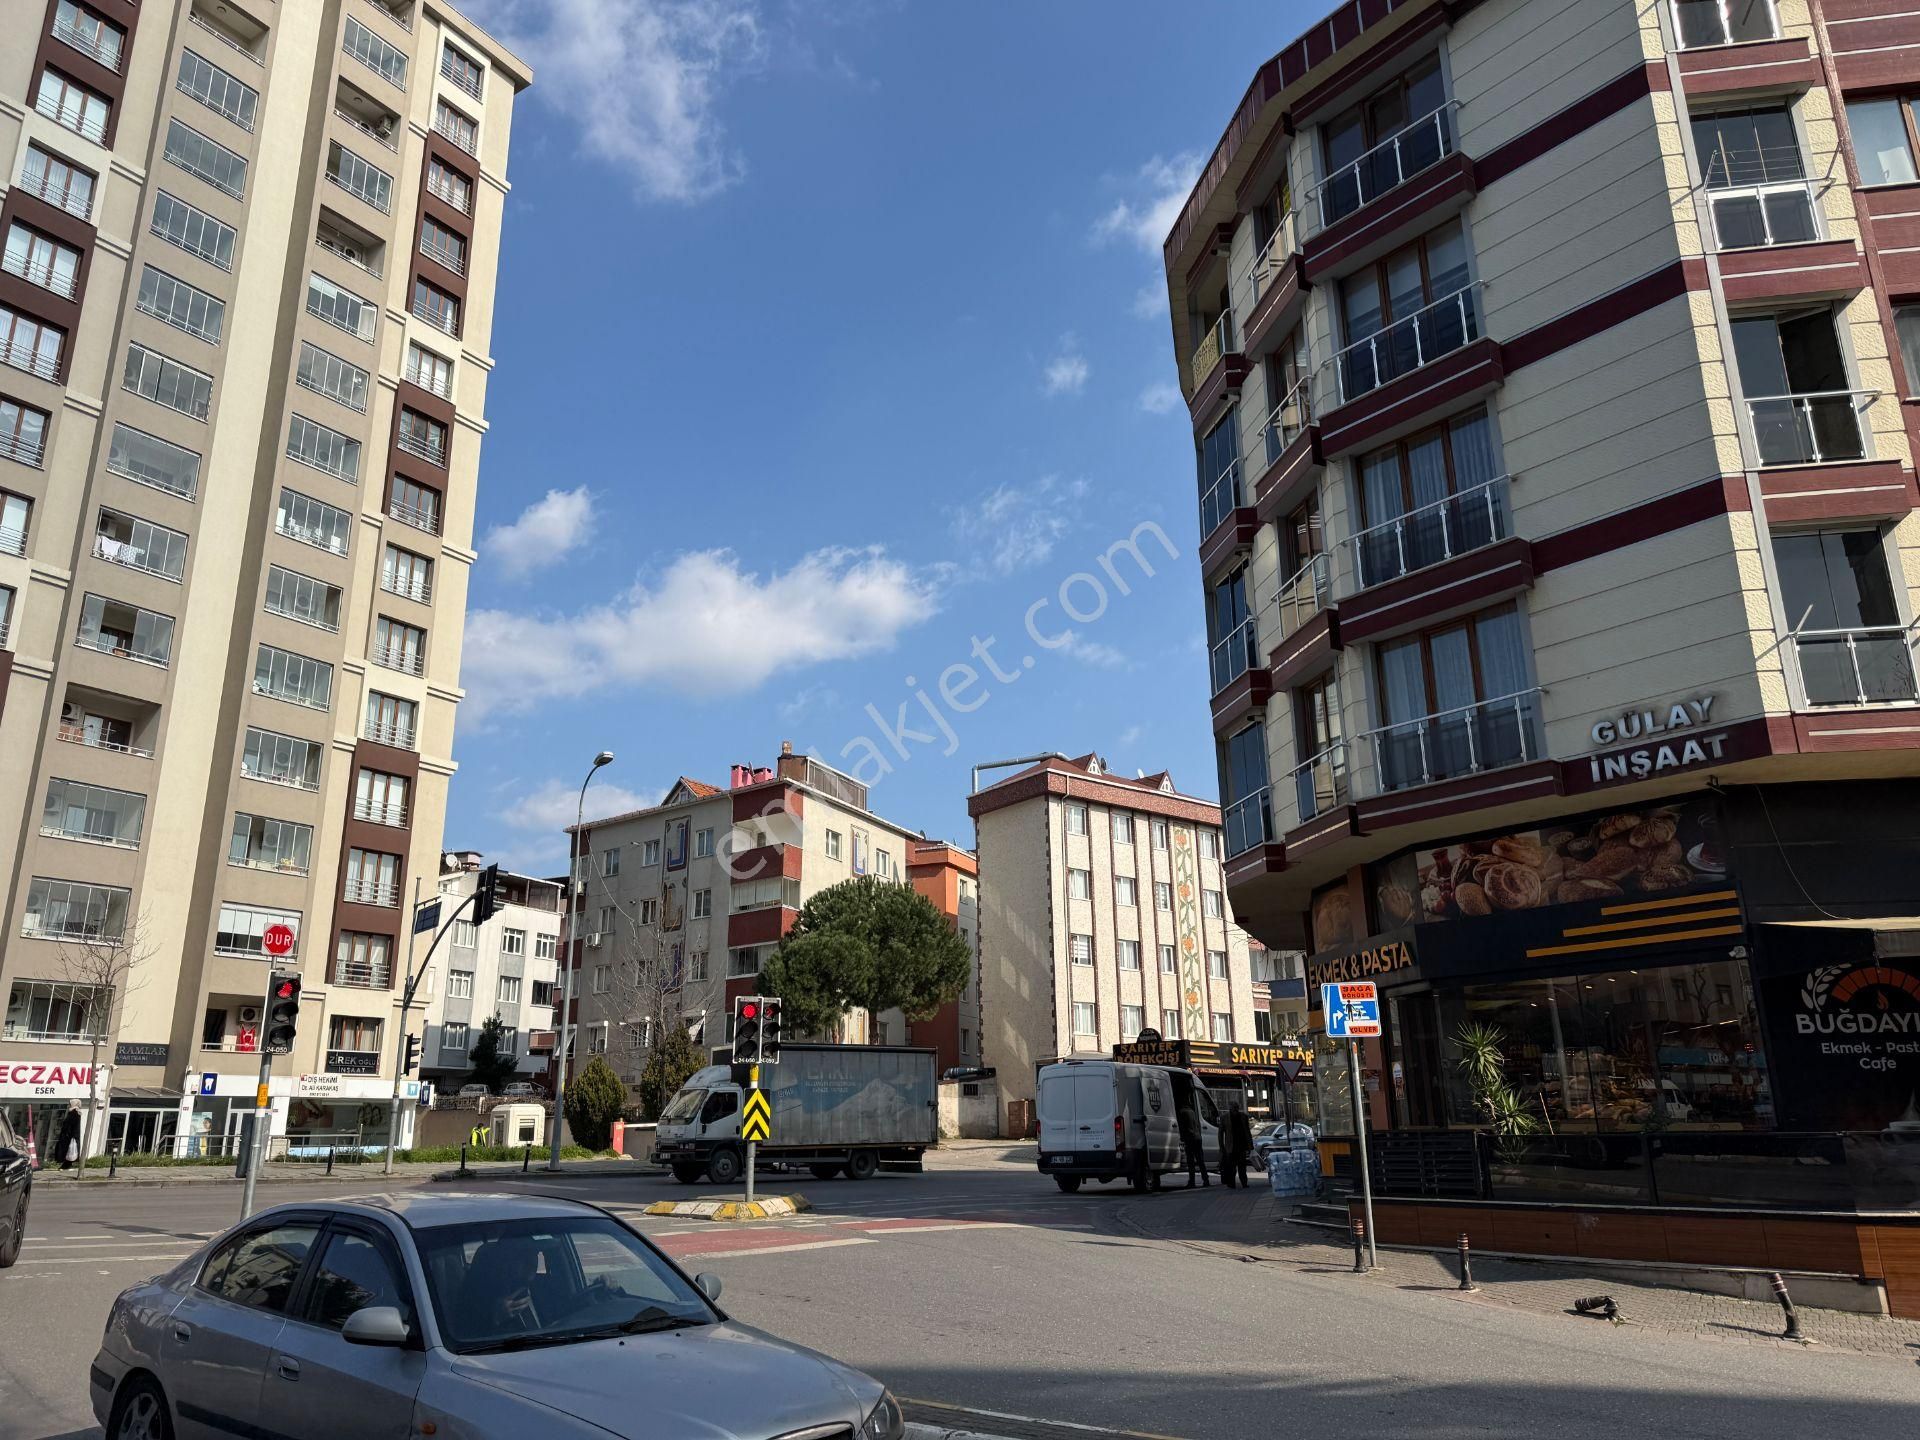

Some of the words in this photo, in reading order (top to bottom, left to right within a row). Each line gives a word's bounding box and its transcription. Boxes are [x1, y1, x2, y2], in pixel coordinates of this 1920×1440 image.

[1591, 696, 1715, 744] GÜLAY
[1590, 732, 1729, 783] İNŞAAT
[266, 932, 292, 947] DUR
[1309, 955, 1349, 990] EKMEK
[1350, 953, 1360, 978] &
[1361, 940, 1412, 976] PASTA
[1121, 1041, 1173, 1053] SARIYER
[1821, 1041, 1872, 1054] Ekmek
[1231, 1046, 1283, 1065] SARIYER
[1859, 1056, 1897, 1072] Cafe
[34, 1086, 55, 1095] ESER
